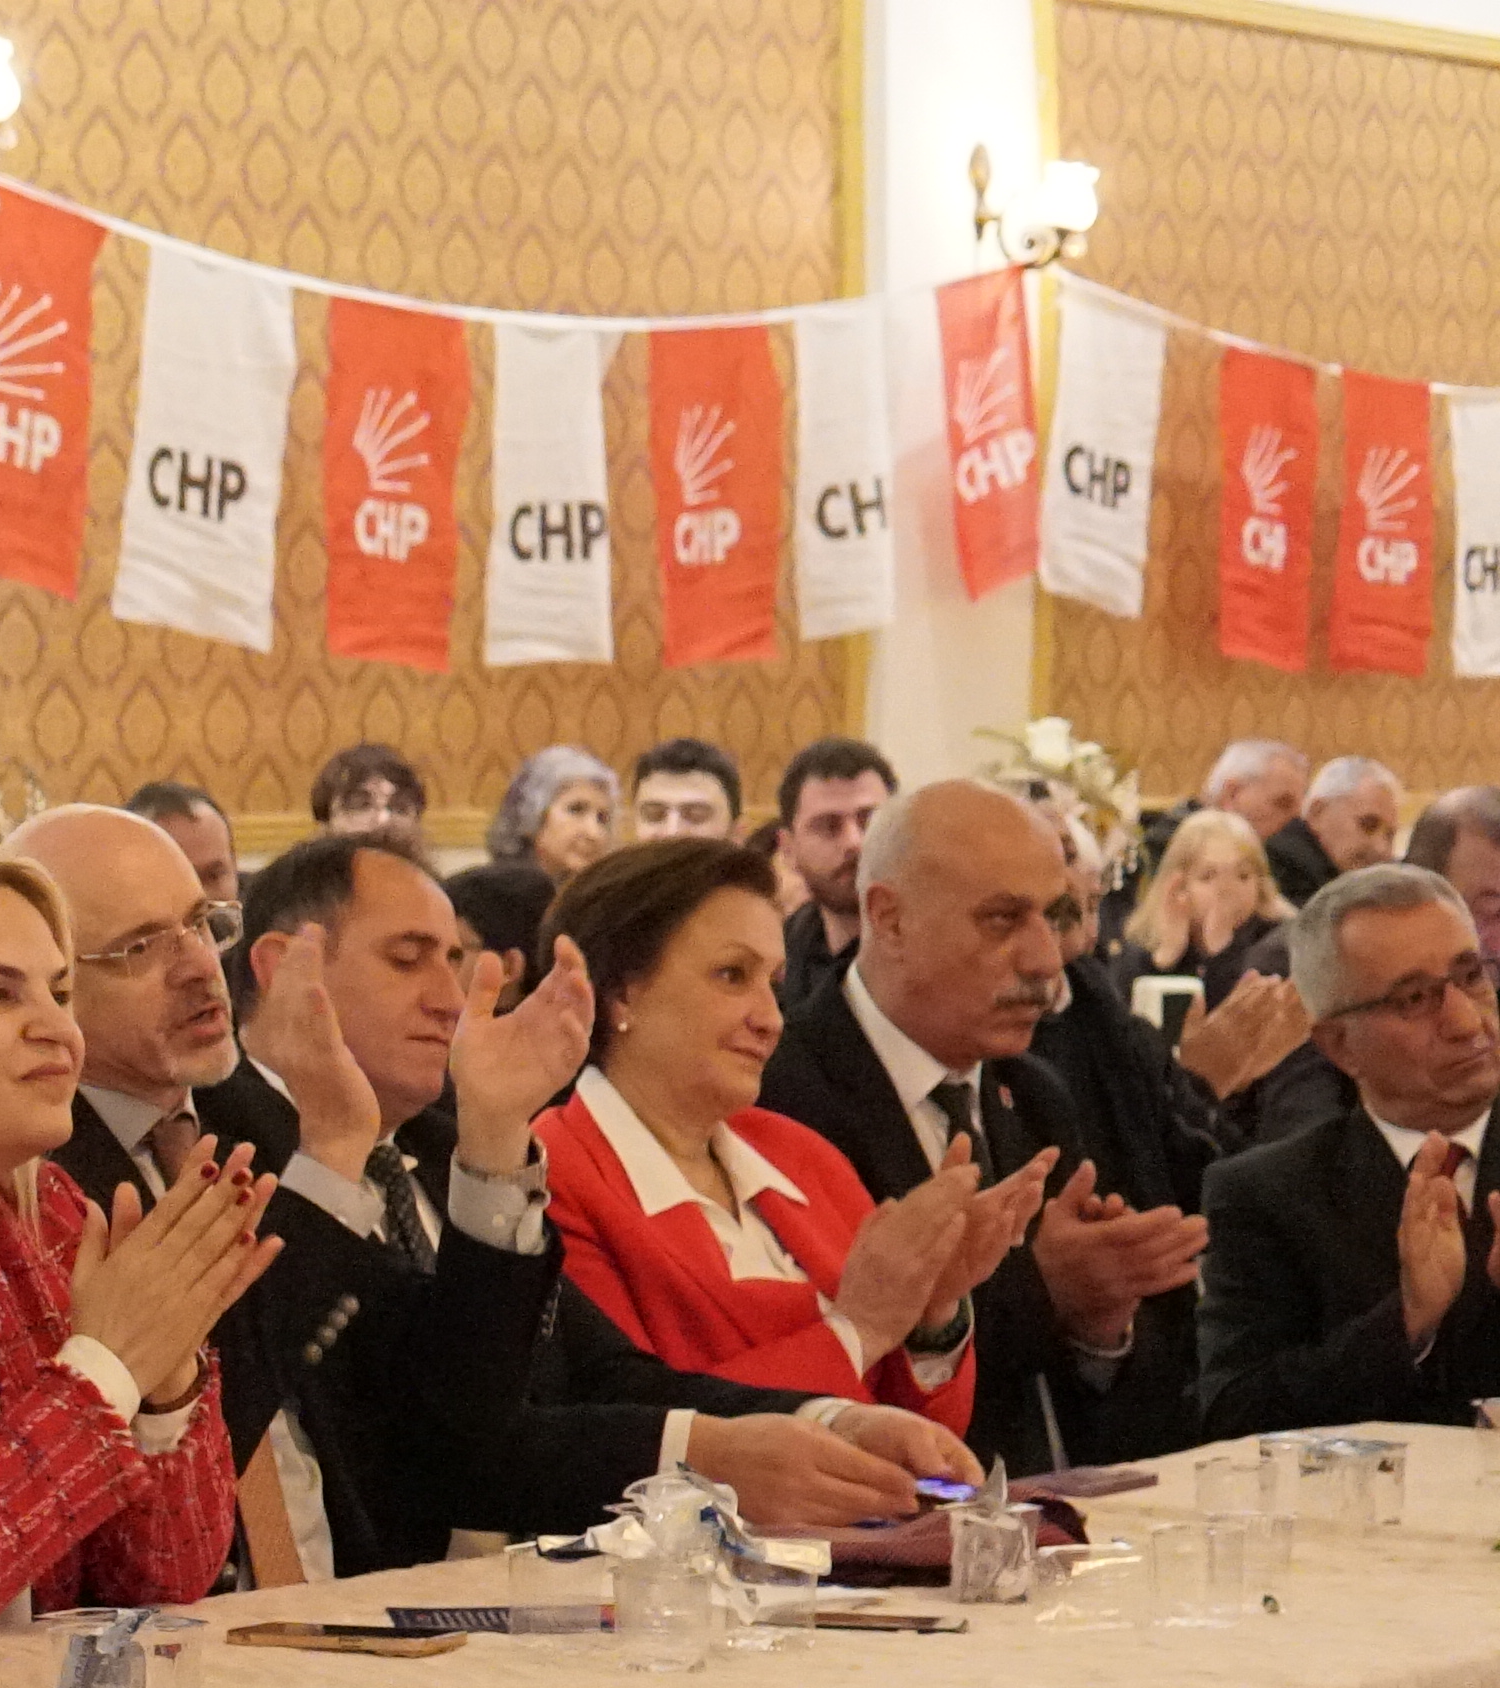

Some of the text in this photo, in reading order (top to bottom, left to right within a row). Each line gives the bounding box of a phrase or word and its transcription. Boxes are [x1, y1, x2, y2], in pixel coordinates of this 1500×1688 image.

[148, 444, 247, 523] CHP
[955, 427, 1036, 506] CHP
[1063, 443, 1131, 511] CHP
[354, 498, 430, 563] CHP
[509, 501, 606, 562] CHP
[671, 508, 742, 565] CHP
[815, 477, 888, 541] CH
[1464, 544, 1500, 594] CH
